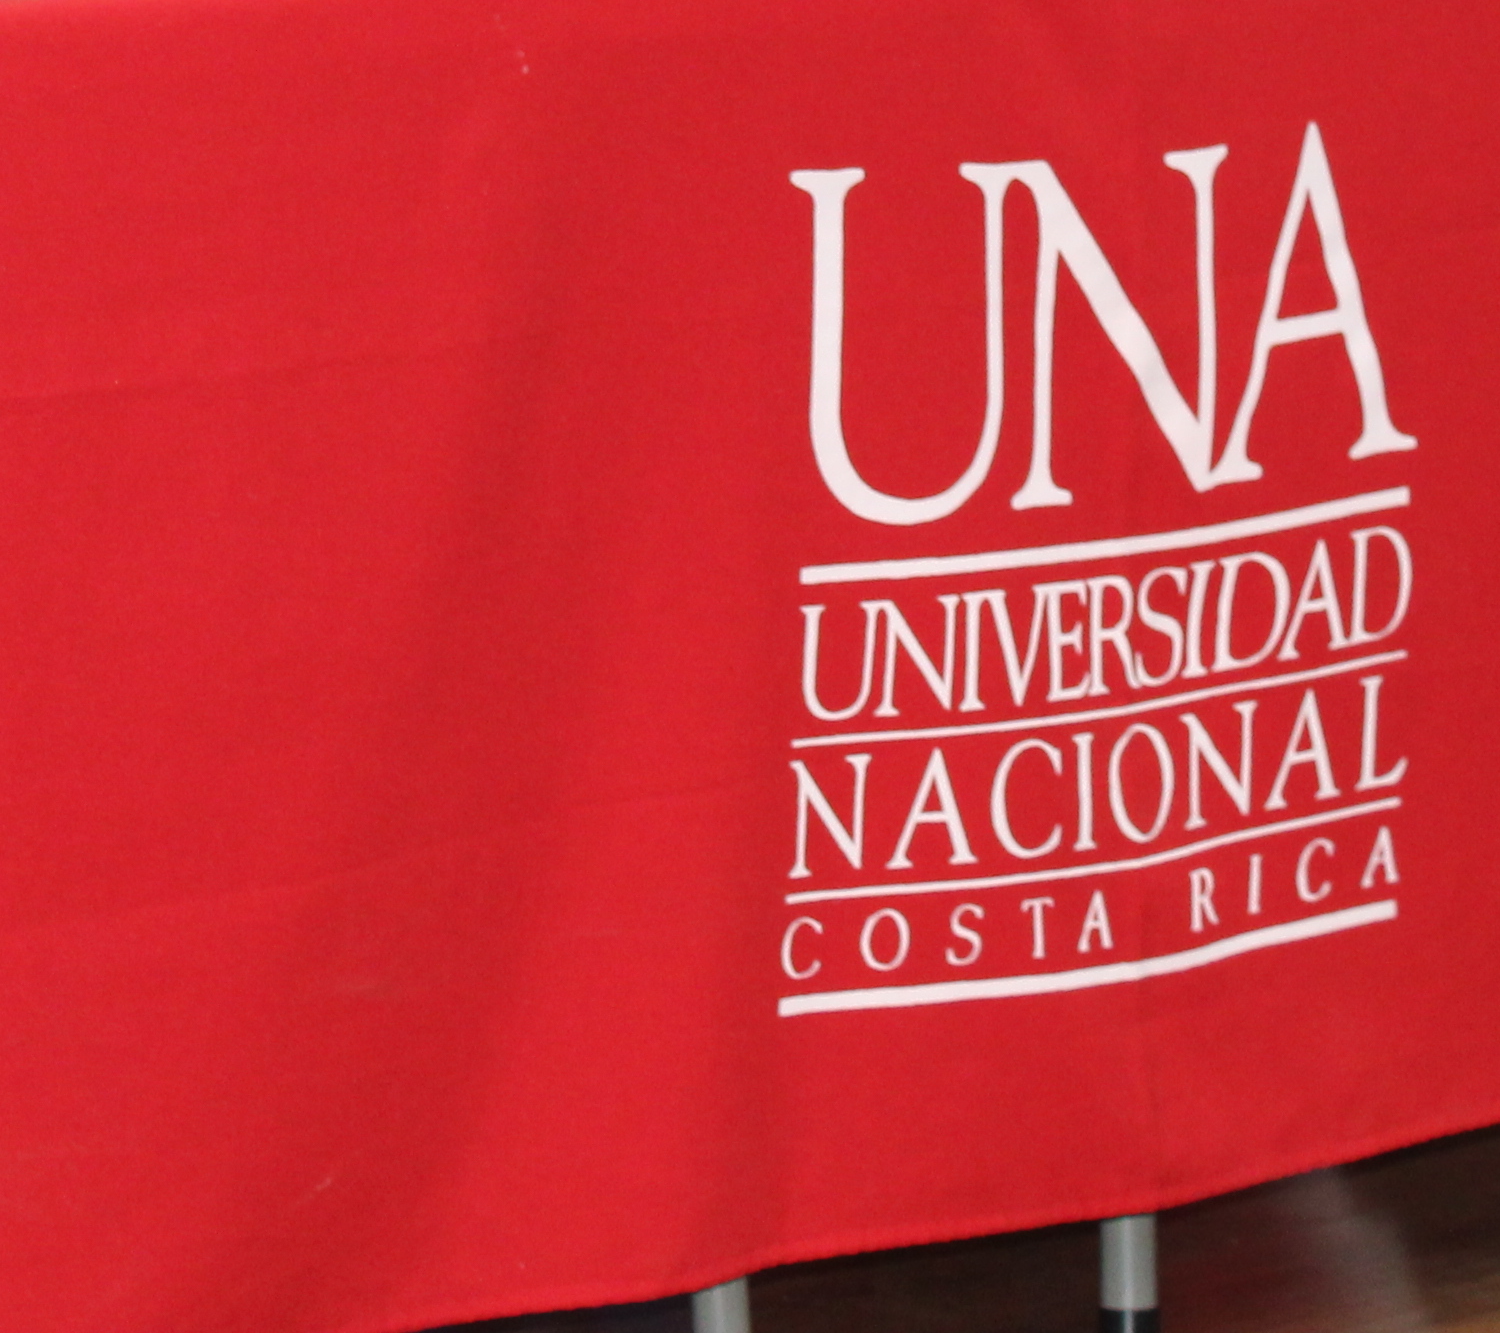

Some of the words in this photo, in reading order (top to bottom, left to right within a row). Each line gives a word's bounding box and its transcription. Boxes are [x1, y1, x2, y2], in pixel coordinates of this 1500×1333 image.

[789, 121, 1418, 526] UNA
[800, 525, 1413, 721] UNIVERSIDAD
[788, 675, 1407, 879] NACIONAL
[781, 890, 1113, 980] COSTA
[1189, 826, 1399, 932] RICA
